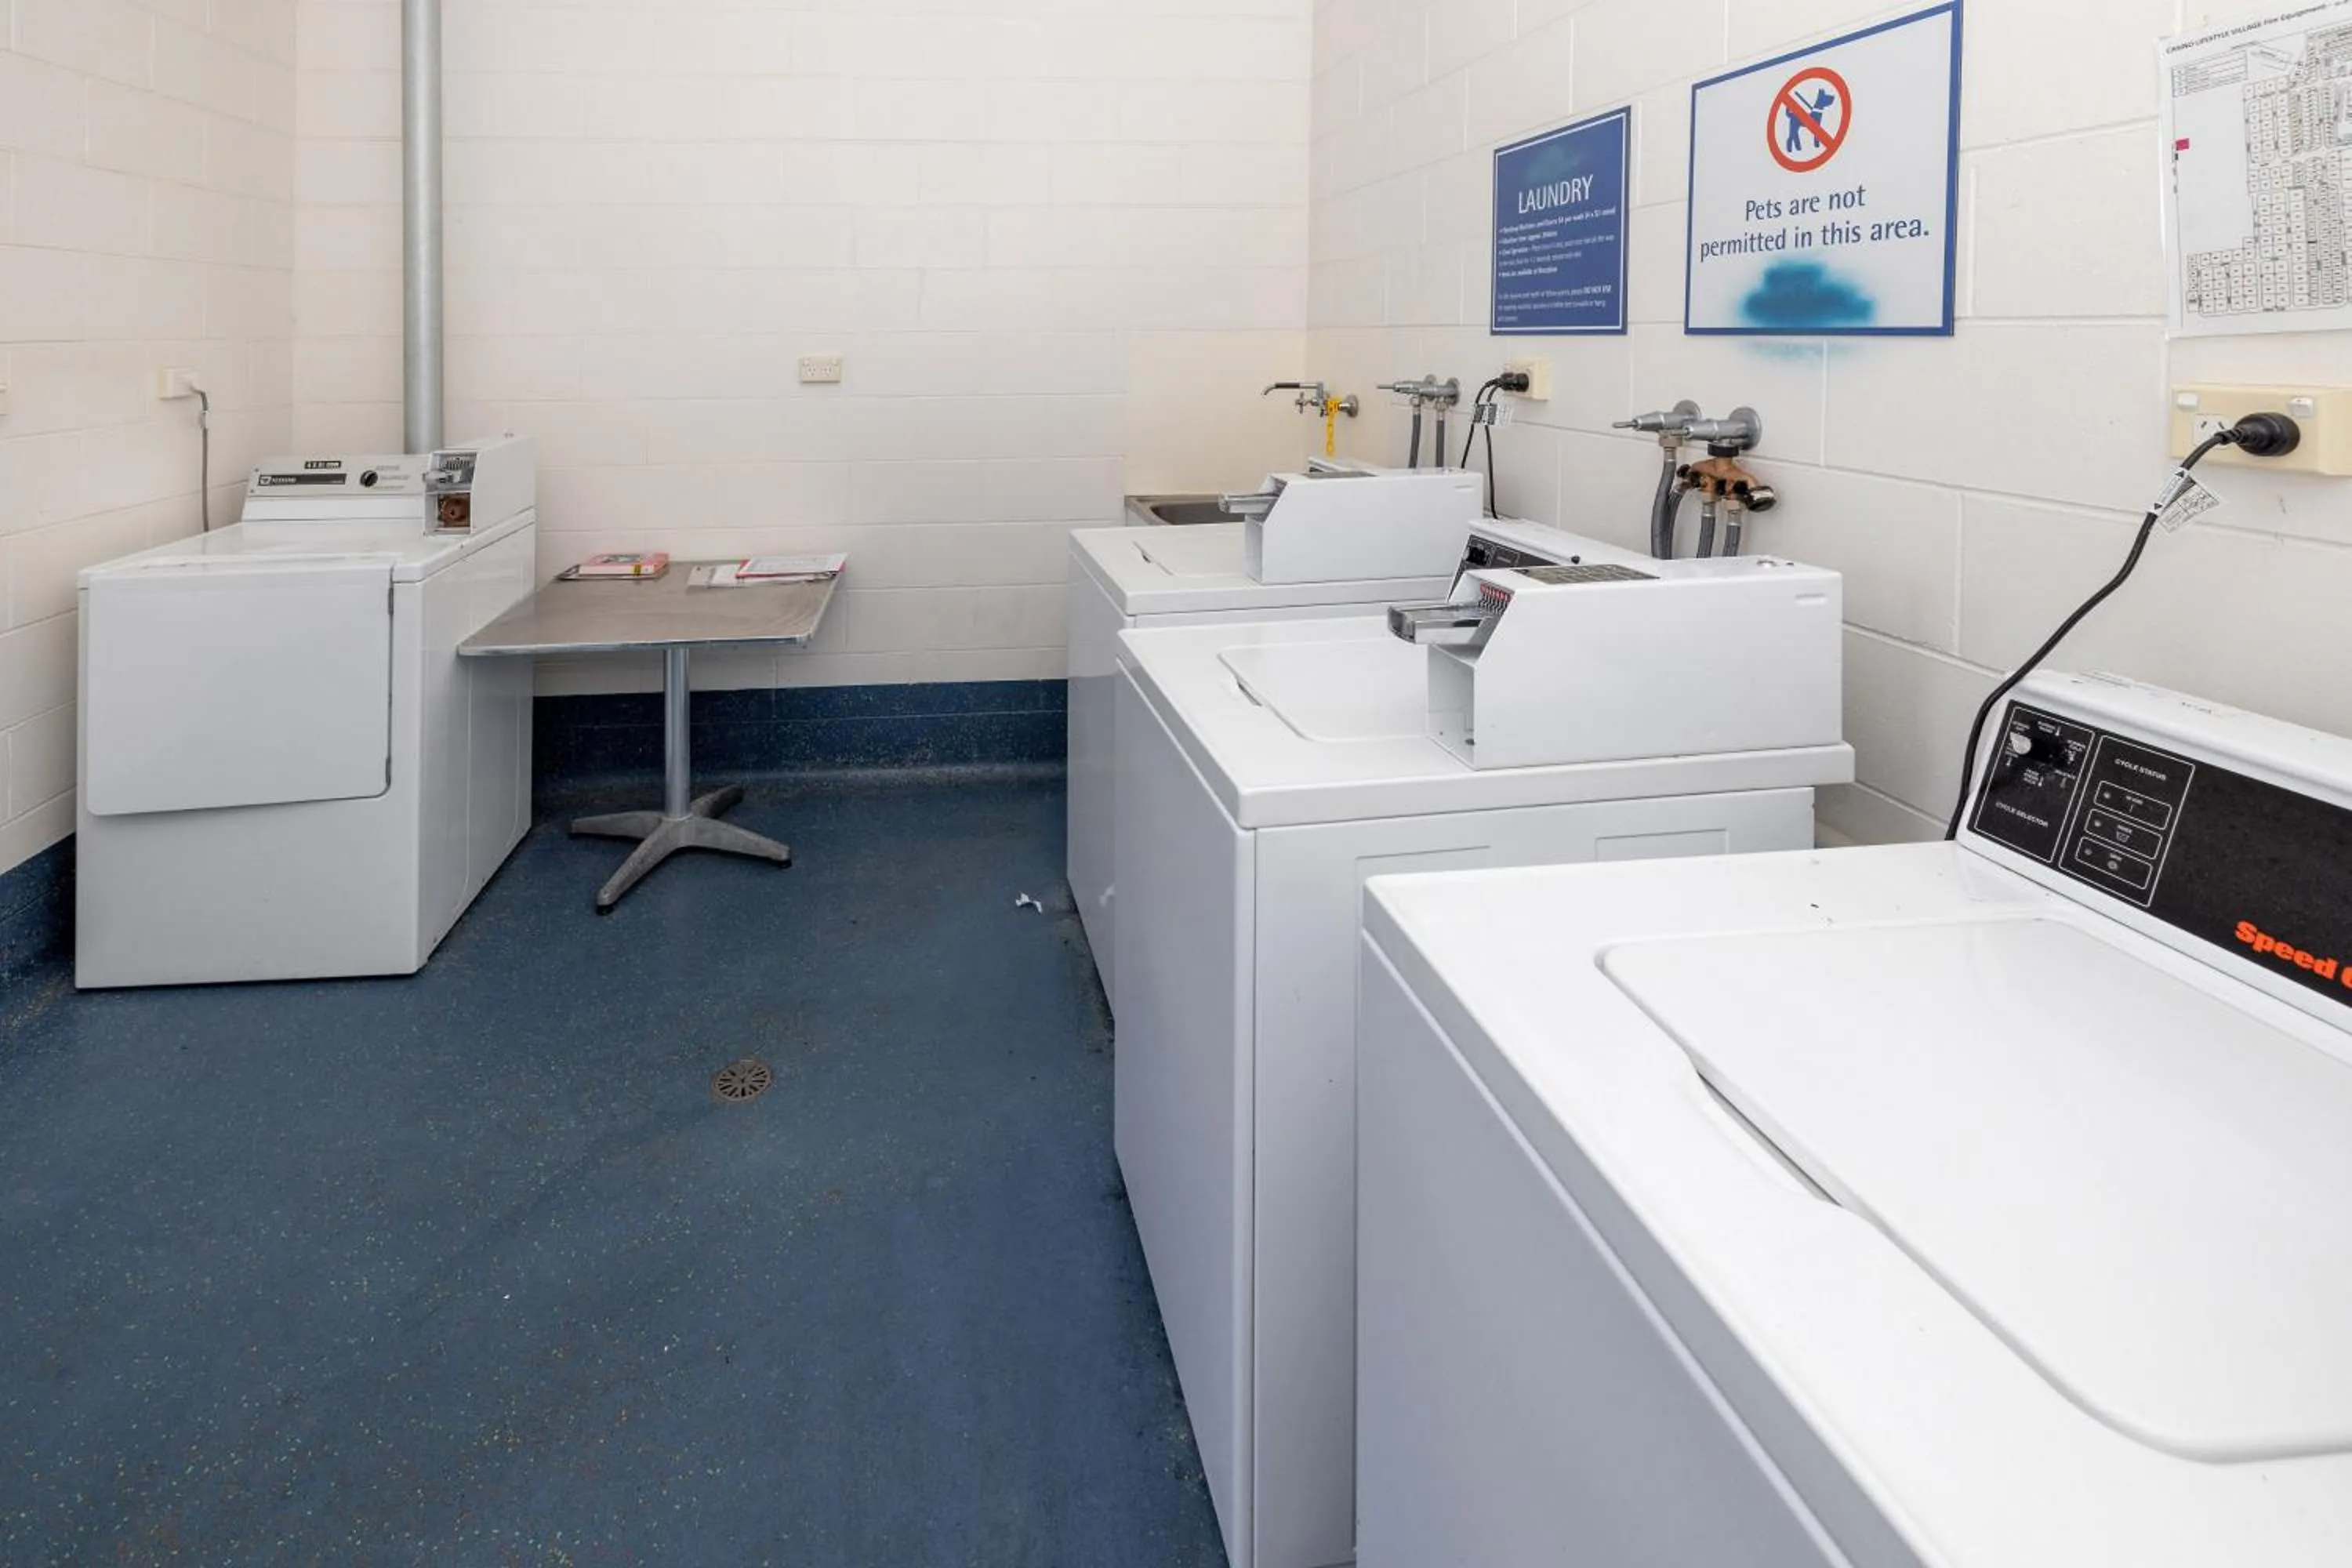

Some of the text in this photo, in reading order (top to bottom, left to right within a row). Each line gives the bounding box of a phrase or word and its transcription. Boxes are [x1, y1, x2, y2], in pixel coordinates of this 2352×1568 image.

[1518, 174, 1594, 213] LAUNDRY
[1745, 184, 1867, 222] Pets are not
[1700, 219, 1929, 262] permitted in this area.
[2235, 920, 2339, 980] Speed
